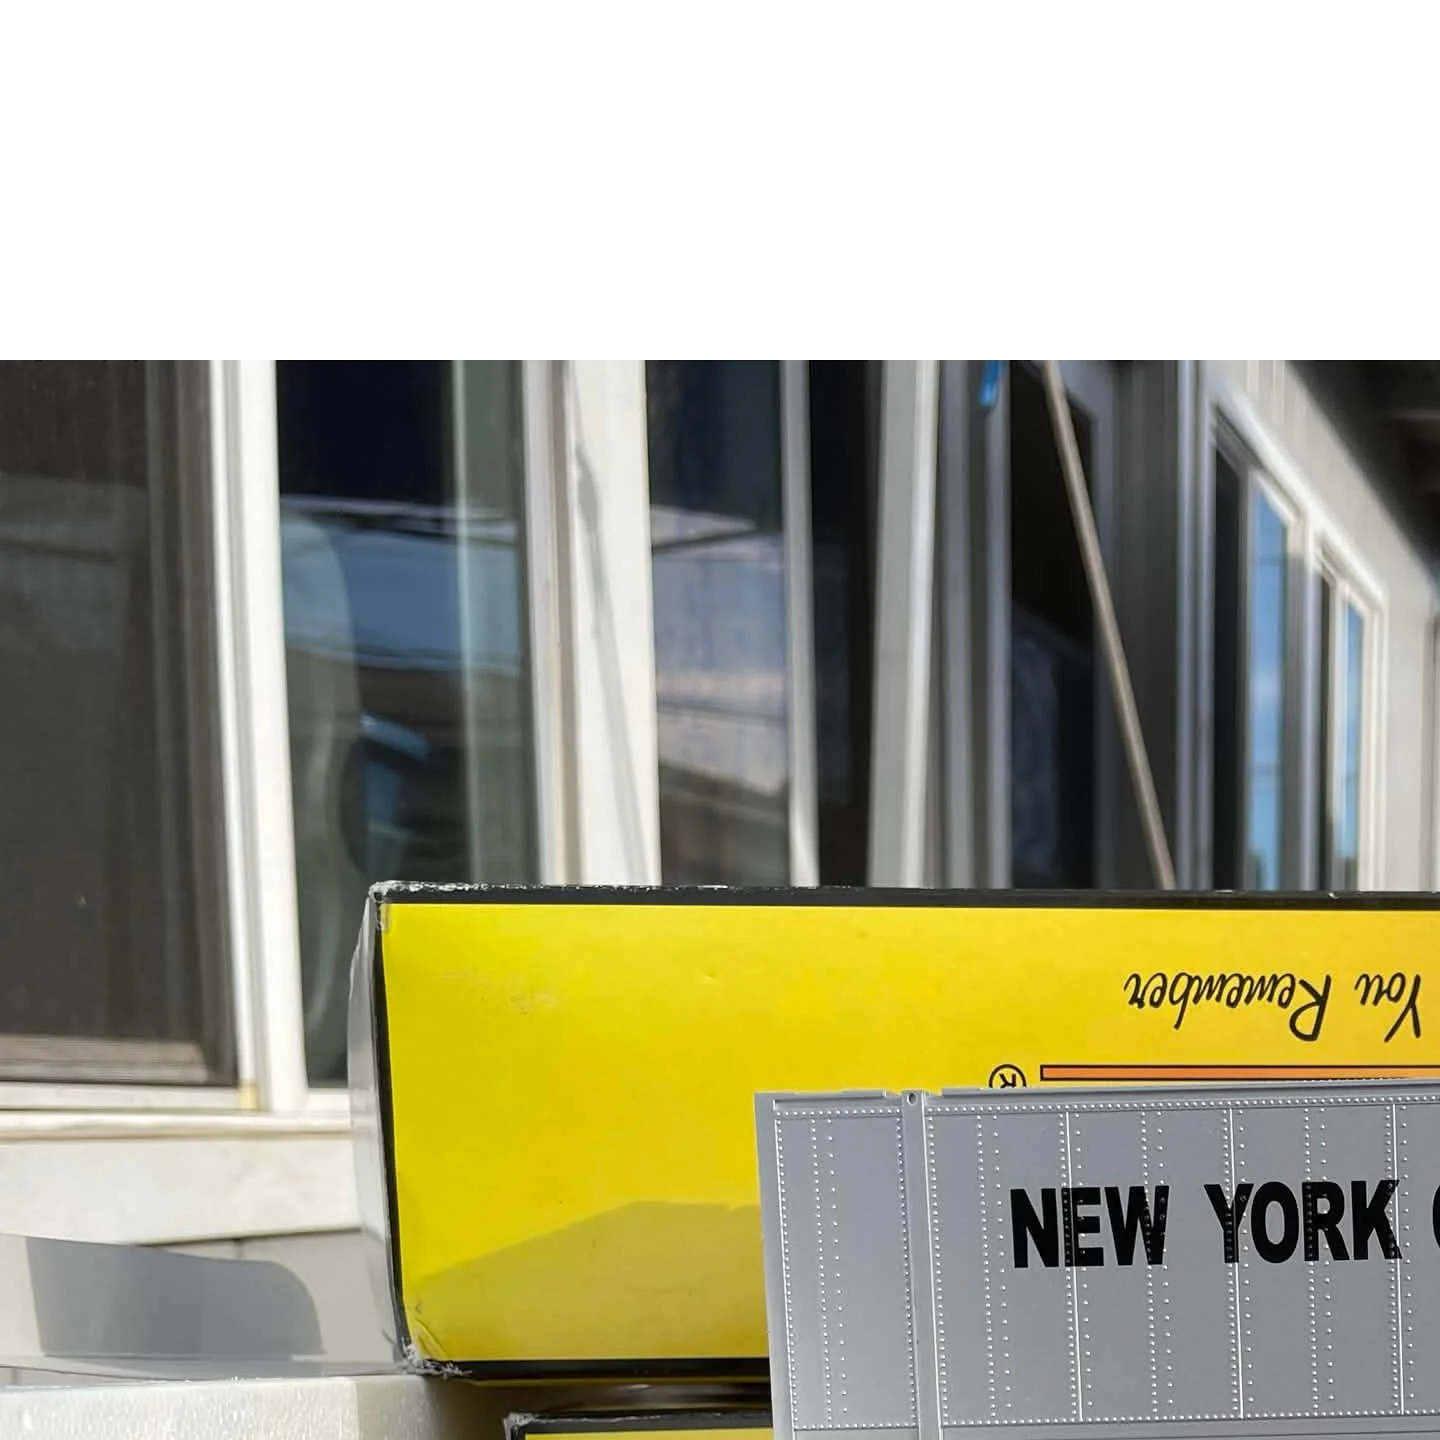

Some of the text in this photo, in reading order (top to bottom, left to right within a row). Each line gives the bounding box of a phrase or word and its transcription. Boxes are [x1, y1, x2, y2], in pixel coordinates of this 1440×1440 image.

[1123, 972, 1332, 1043] Remember
[1354, 973, 1422, 1043] You
[1010, 1186, 1170, 1270] NEW
[1203, 1179, 1402, 1266] YORK
